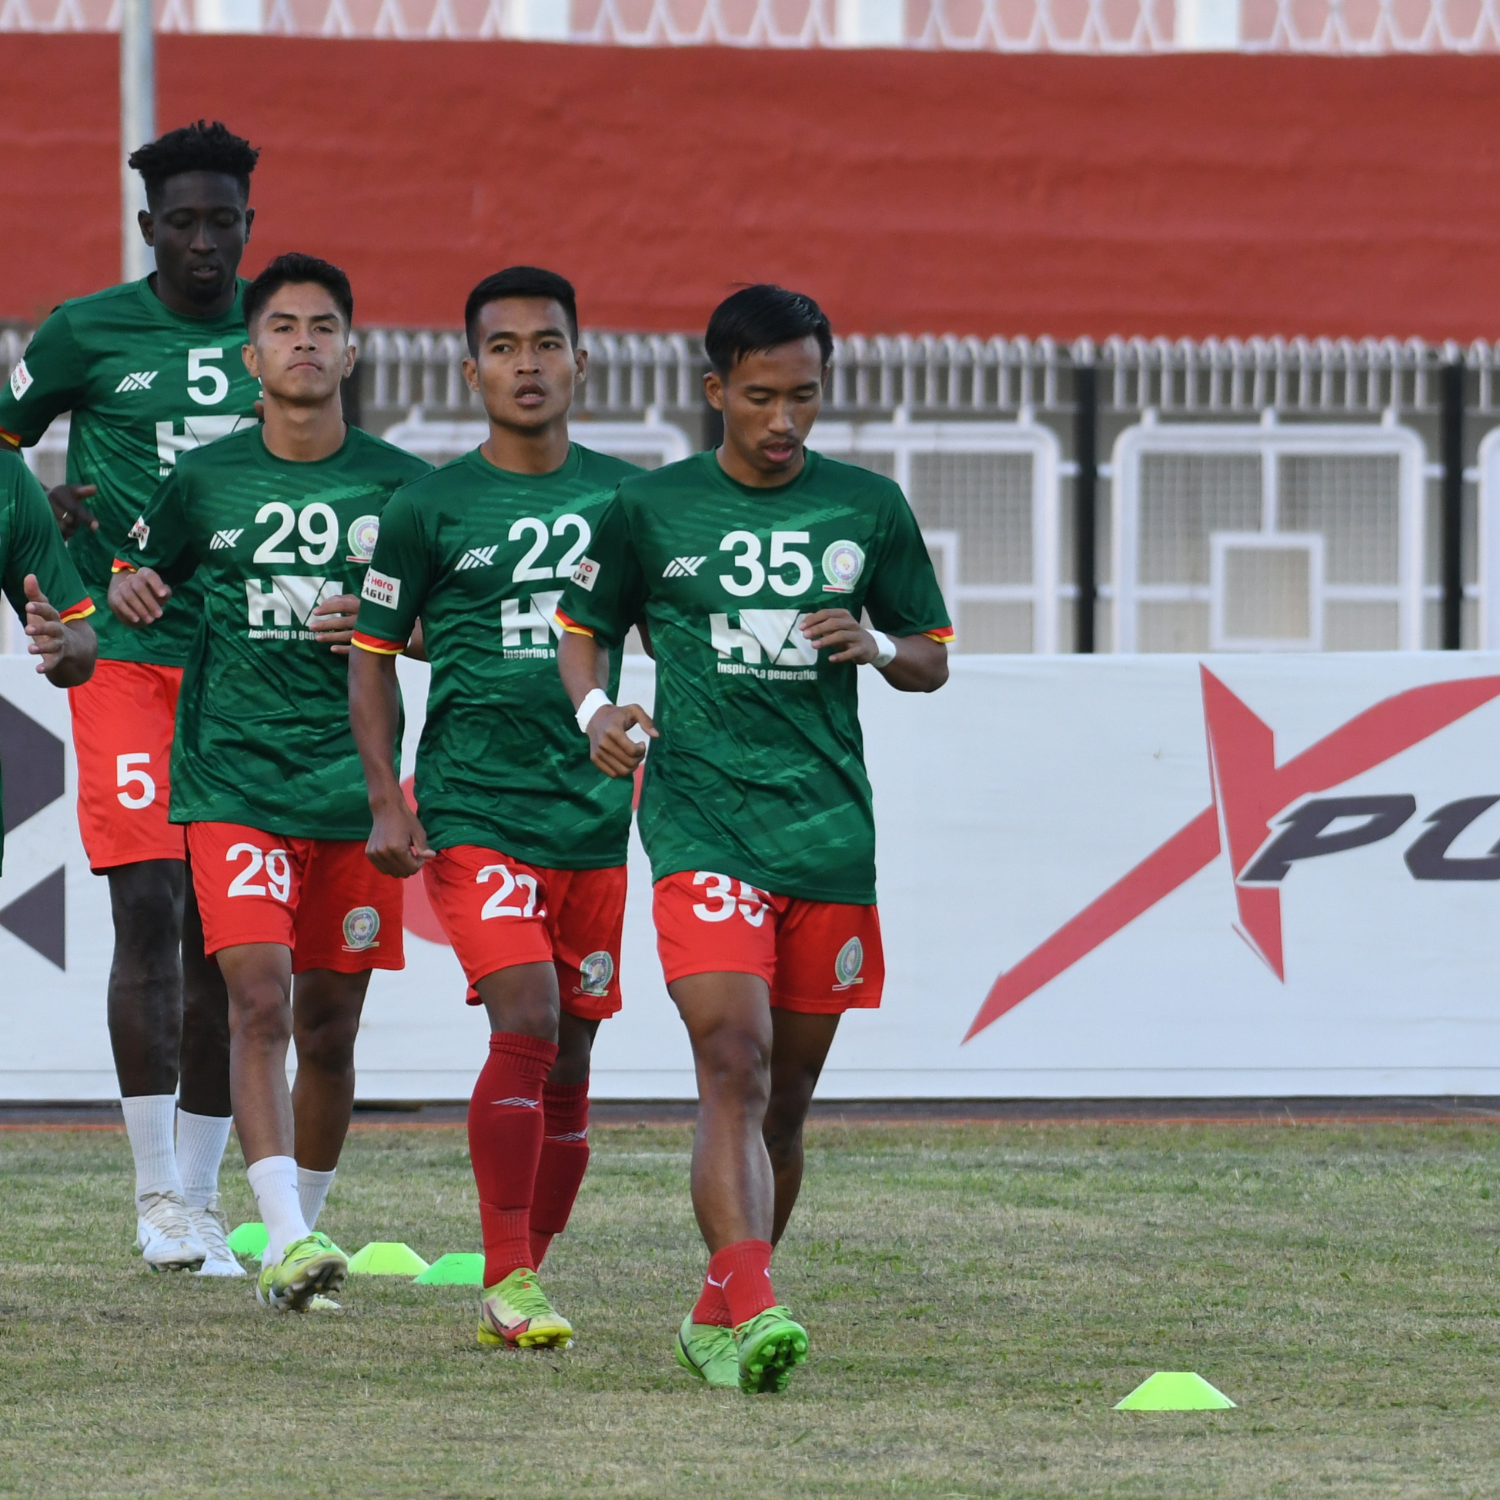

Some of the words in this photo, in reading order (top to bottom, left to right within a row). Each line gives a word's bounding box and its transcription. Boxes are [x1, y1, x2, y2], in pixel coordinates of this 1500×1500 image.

[187, 348, 229, 405] 5
[156, 415, 259, 465] HV
[253, 502, 340, 565] 29
[508, 514, 591, 583] 22
[371, 576, 394, 592] Hero
[719, 531, 814, 597] 35
[501, 590, 565, 647] HV
[503, 648, 548, 660] Inspiring
[117, 752, 156, 809] 5
[226, 842, 291, 903] 29
[476, 864, 545, 921] 22
[692, 871, 770, 927] 35
